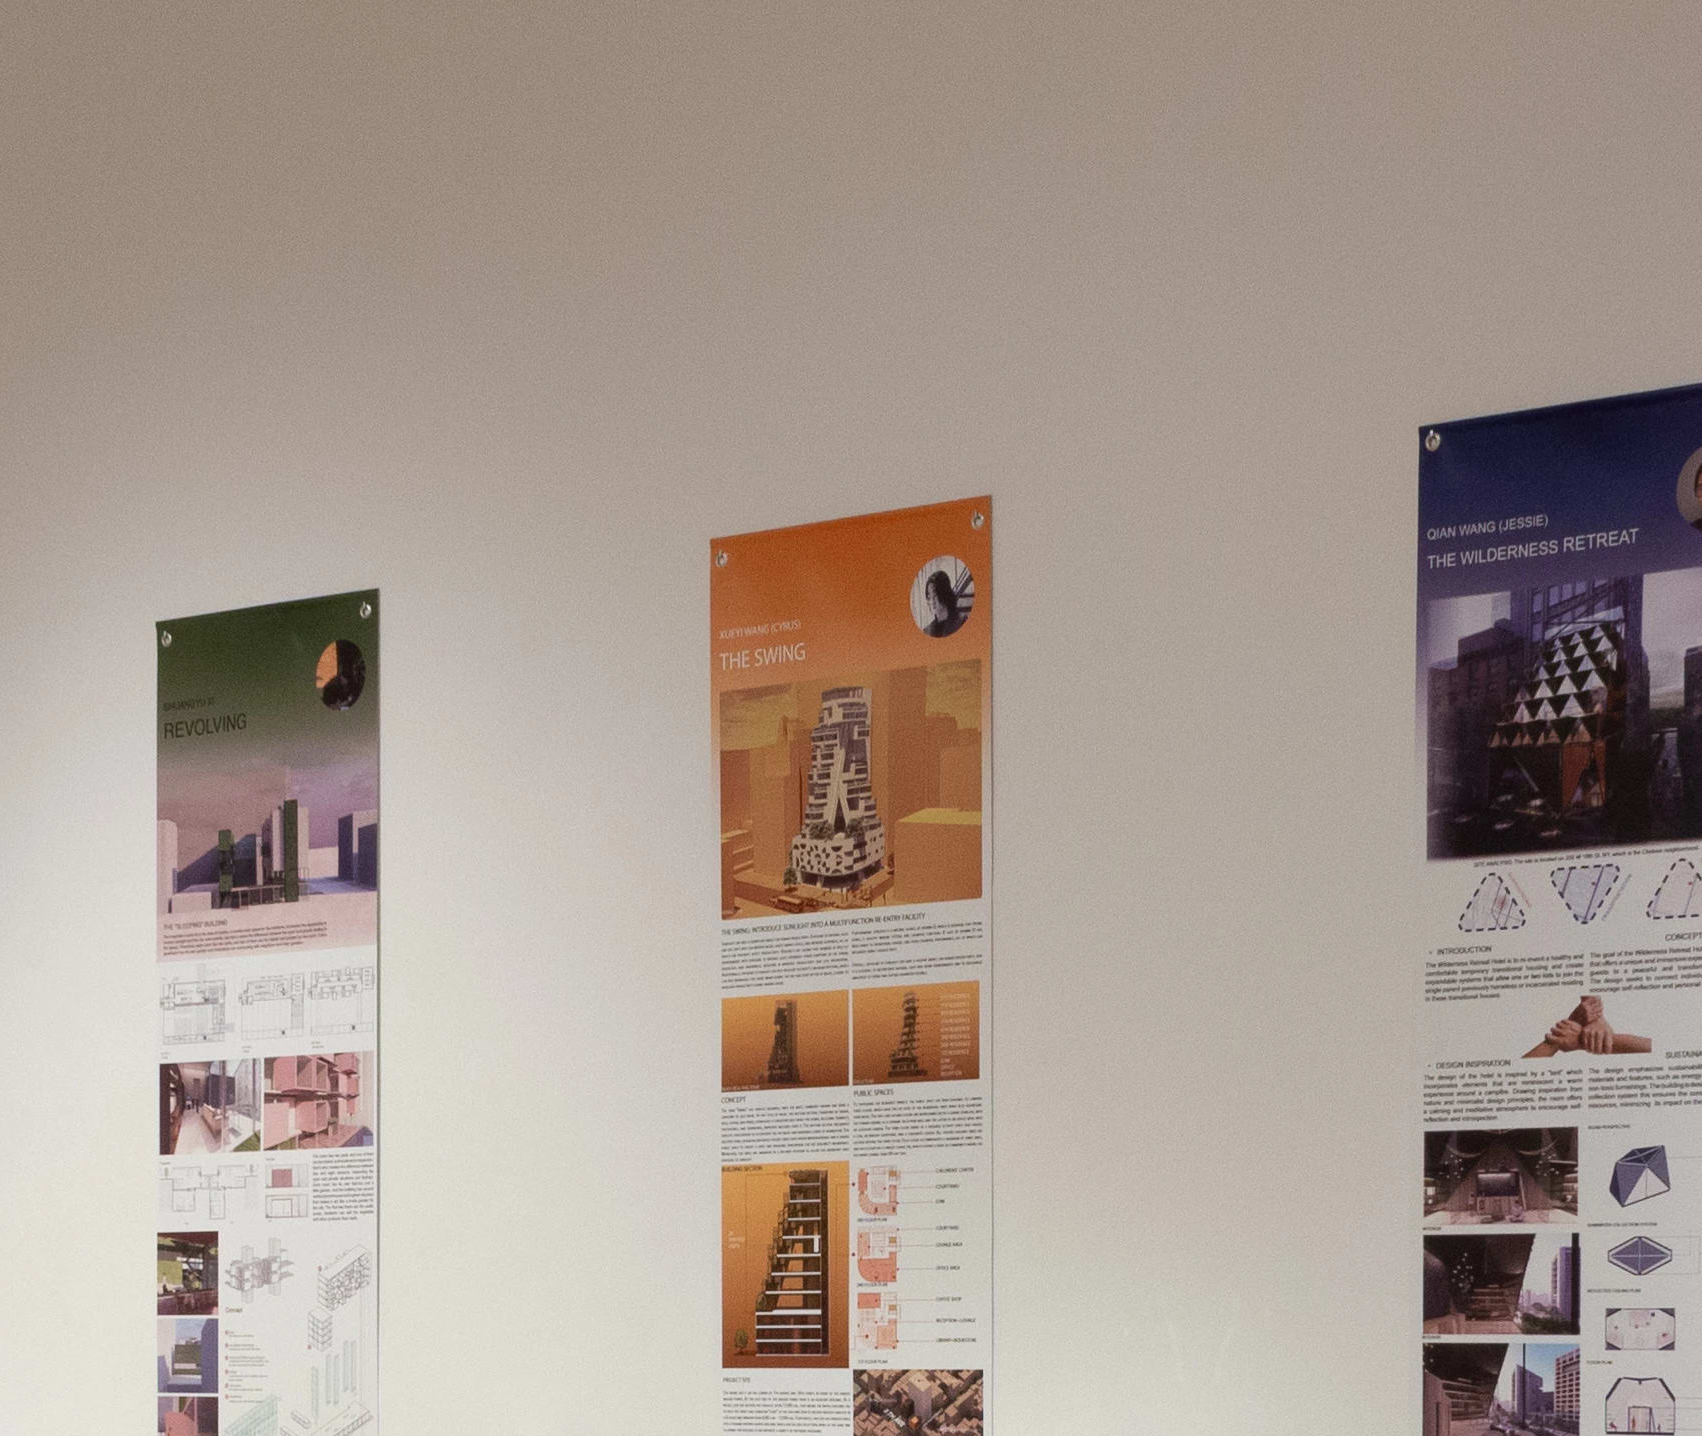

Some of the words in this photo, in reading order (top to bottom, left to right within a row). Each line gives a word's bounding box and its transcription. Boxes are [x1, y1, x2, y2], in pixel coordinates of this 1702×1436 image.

[1427, 526, 1456, 540] QIAN
[1459, 521, 1496, 536] WANG
[1498, 514, 1549, 533] (JESSIE)
[1427, 553, 1456, 569] THE
[1460, 540, 1559, 566] WILDERNESS
[1563, 528, 1640, 553] RETREAT
[719, 650, 750, 671] THE
[754, 642, 806, 667] SWING
[163, 713, 247, 739] REVOLVING
[1437, 945, 1492, 955] INTRODUCTION
[1665, 932, 1702, 942] CONCEPT
